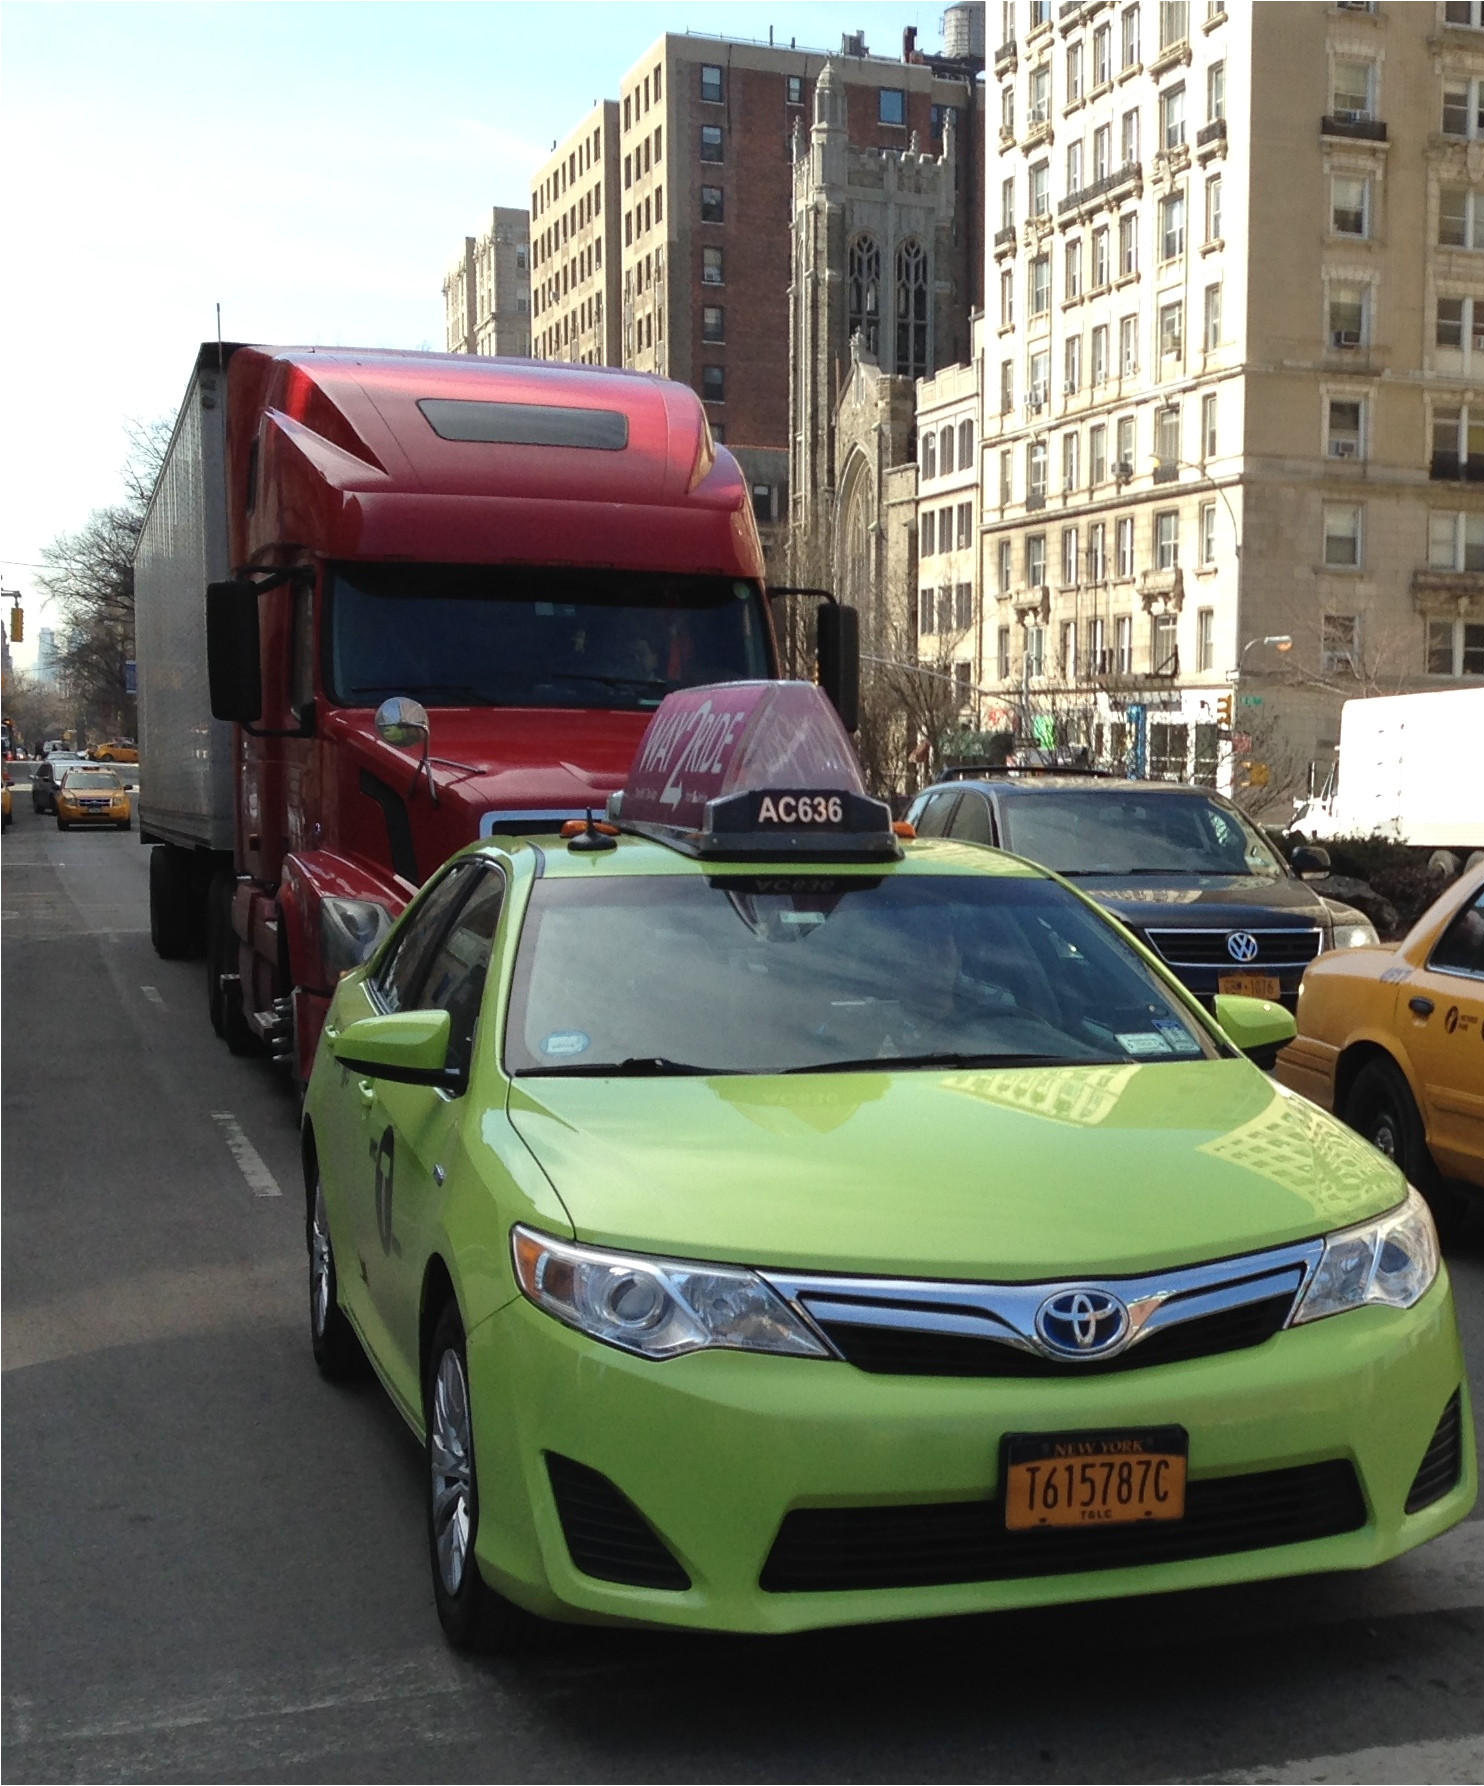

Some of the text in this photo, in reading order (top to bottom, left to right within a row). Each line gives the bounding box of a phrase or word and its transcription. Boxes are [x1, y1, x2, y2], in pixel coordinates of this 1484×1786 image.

[758, 796, 843, 823] AC636
[1054, 1440, 1144, 1457] NEW YORK
[1025, 1459, 1170, 1511] T615787C
